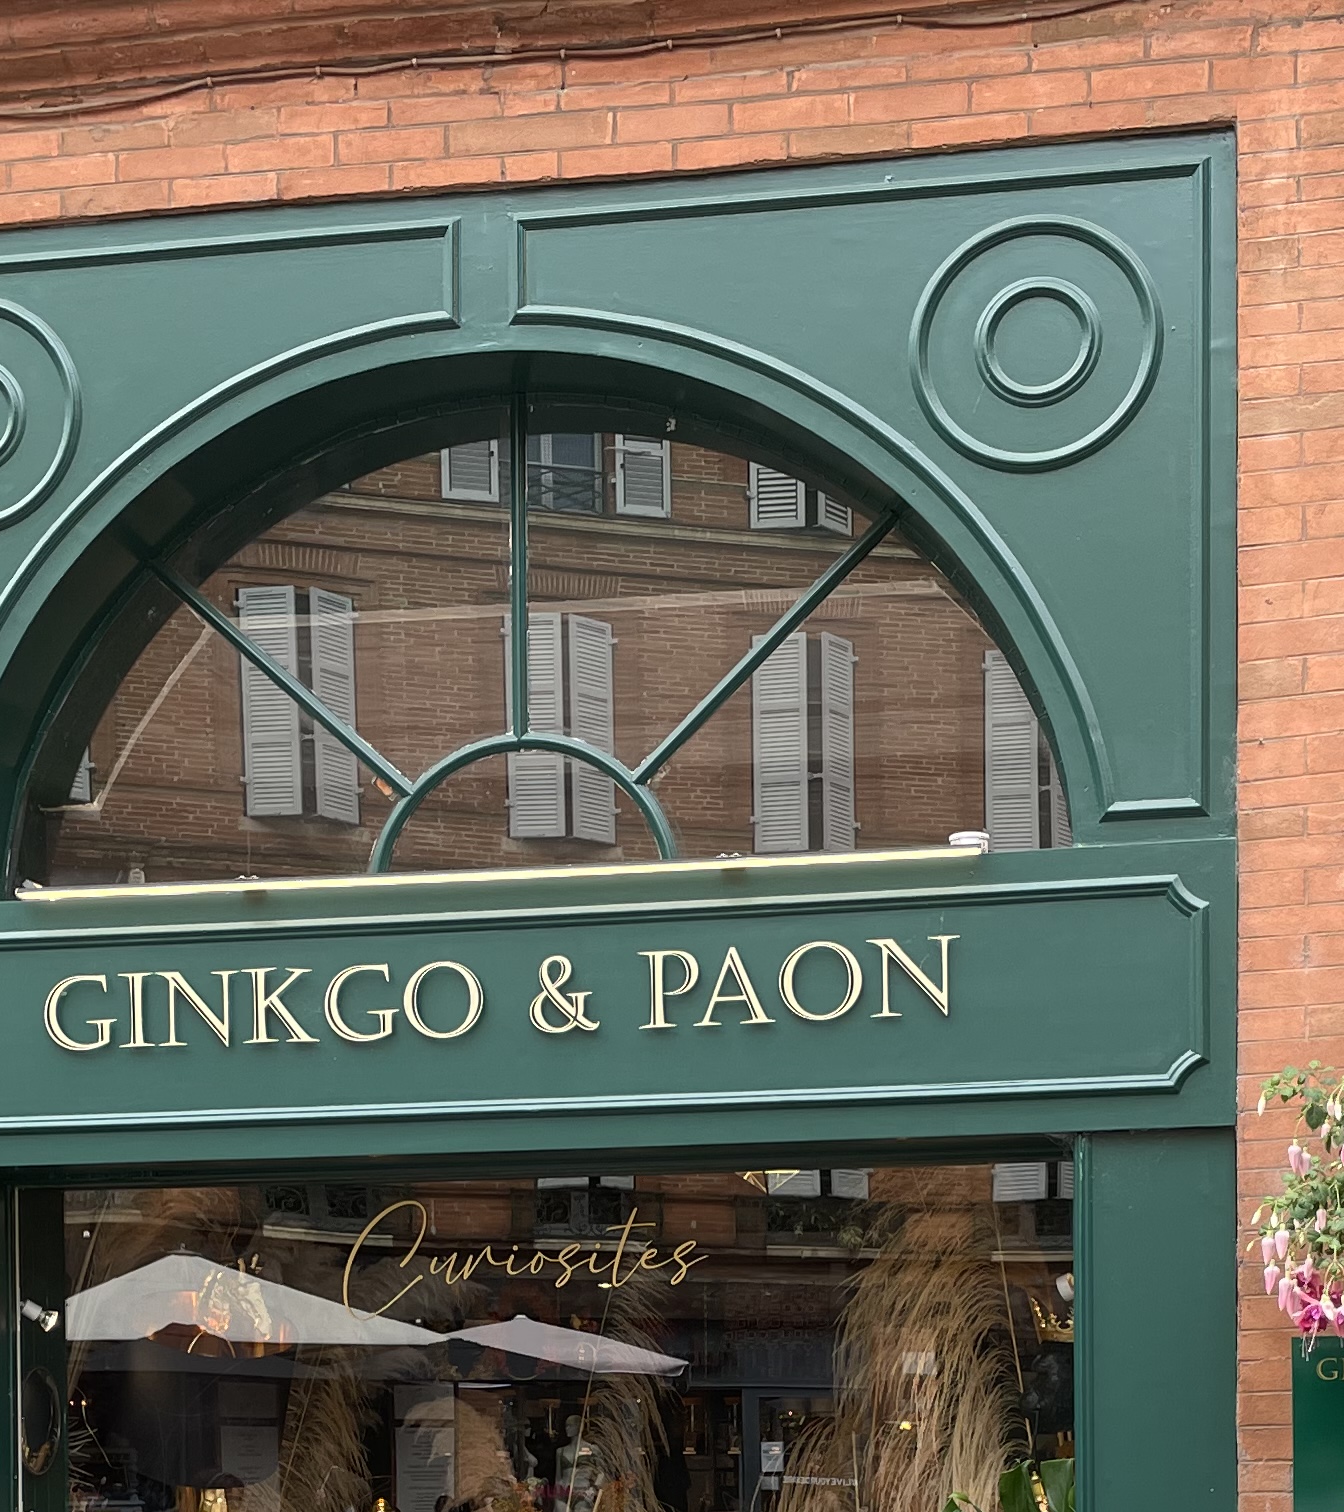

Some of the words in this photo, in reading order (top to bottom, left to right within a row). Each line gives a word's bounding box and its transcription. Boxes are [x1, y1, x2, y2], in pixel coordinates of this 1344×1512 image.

[43, 961, 484, 1051] GINKGO
[529, 955, 600, 1033] &
[638, 934, 961, 1030] PAON
